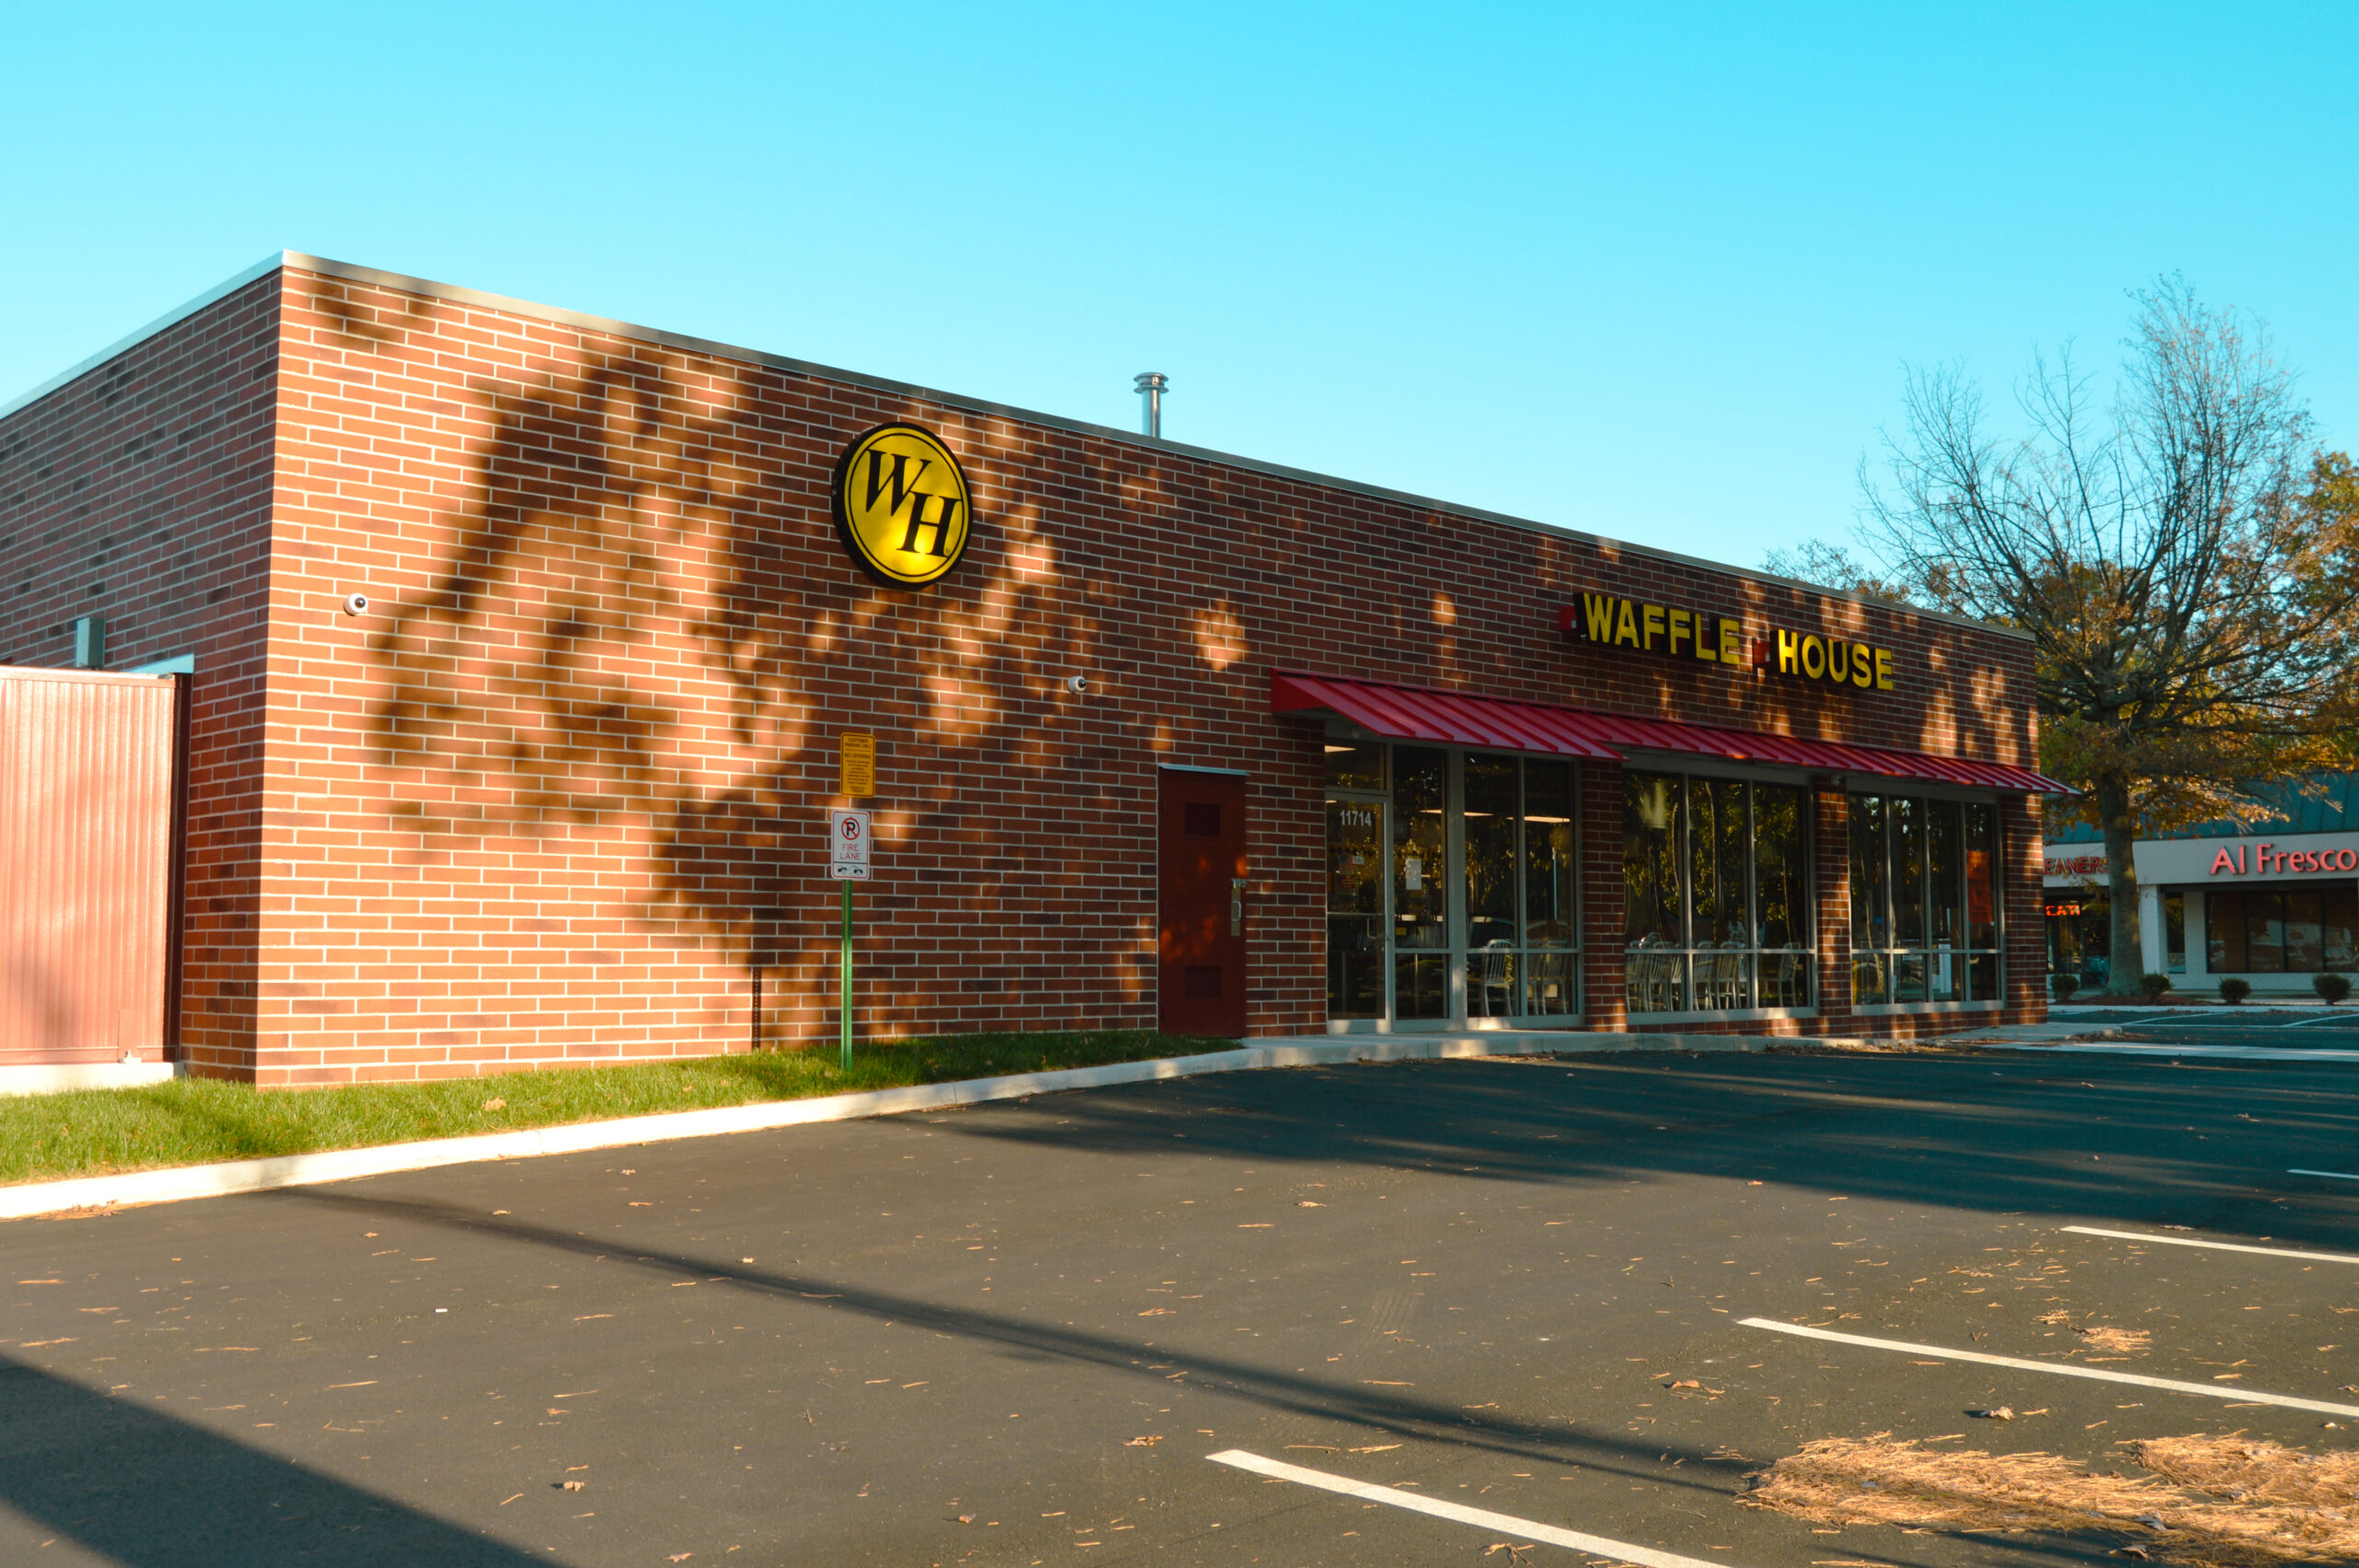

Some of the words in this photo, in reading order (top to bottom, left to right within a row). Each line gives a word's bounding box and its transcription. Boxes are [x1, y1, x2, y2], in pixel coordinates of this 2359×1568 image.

[1582, 592, 1741, 665] WAFFLE
[1778, 628, 1895, 691] HOUSE
[1340, 810, 1372, 826] 11714
[841, 843, 859, 852] FIRE
[839, 852, 861, 860] LANE
[2210, 845, 2246, 874] Al
[2256, 843, 2358, 873] Fresco
